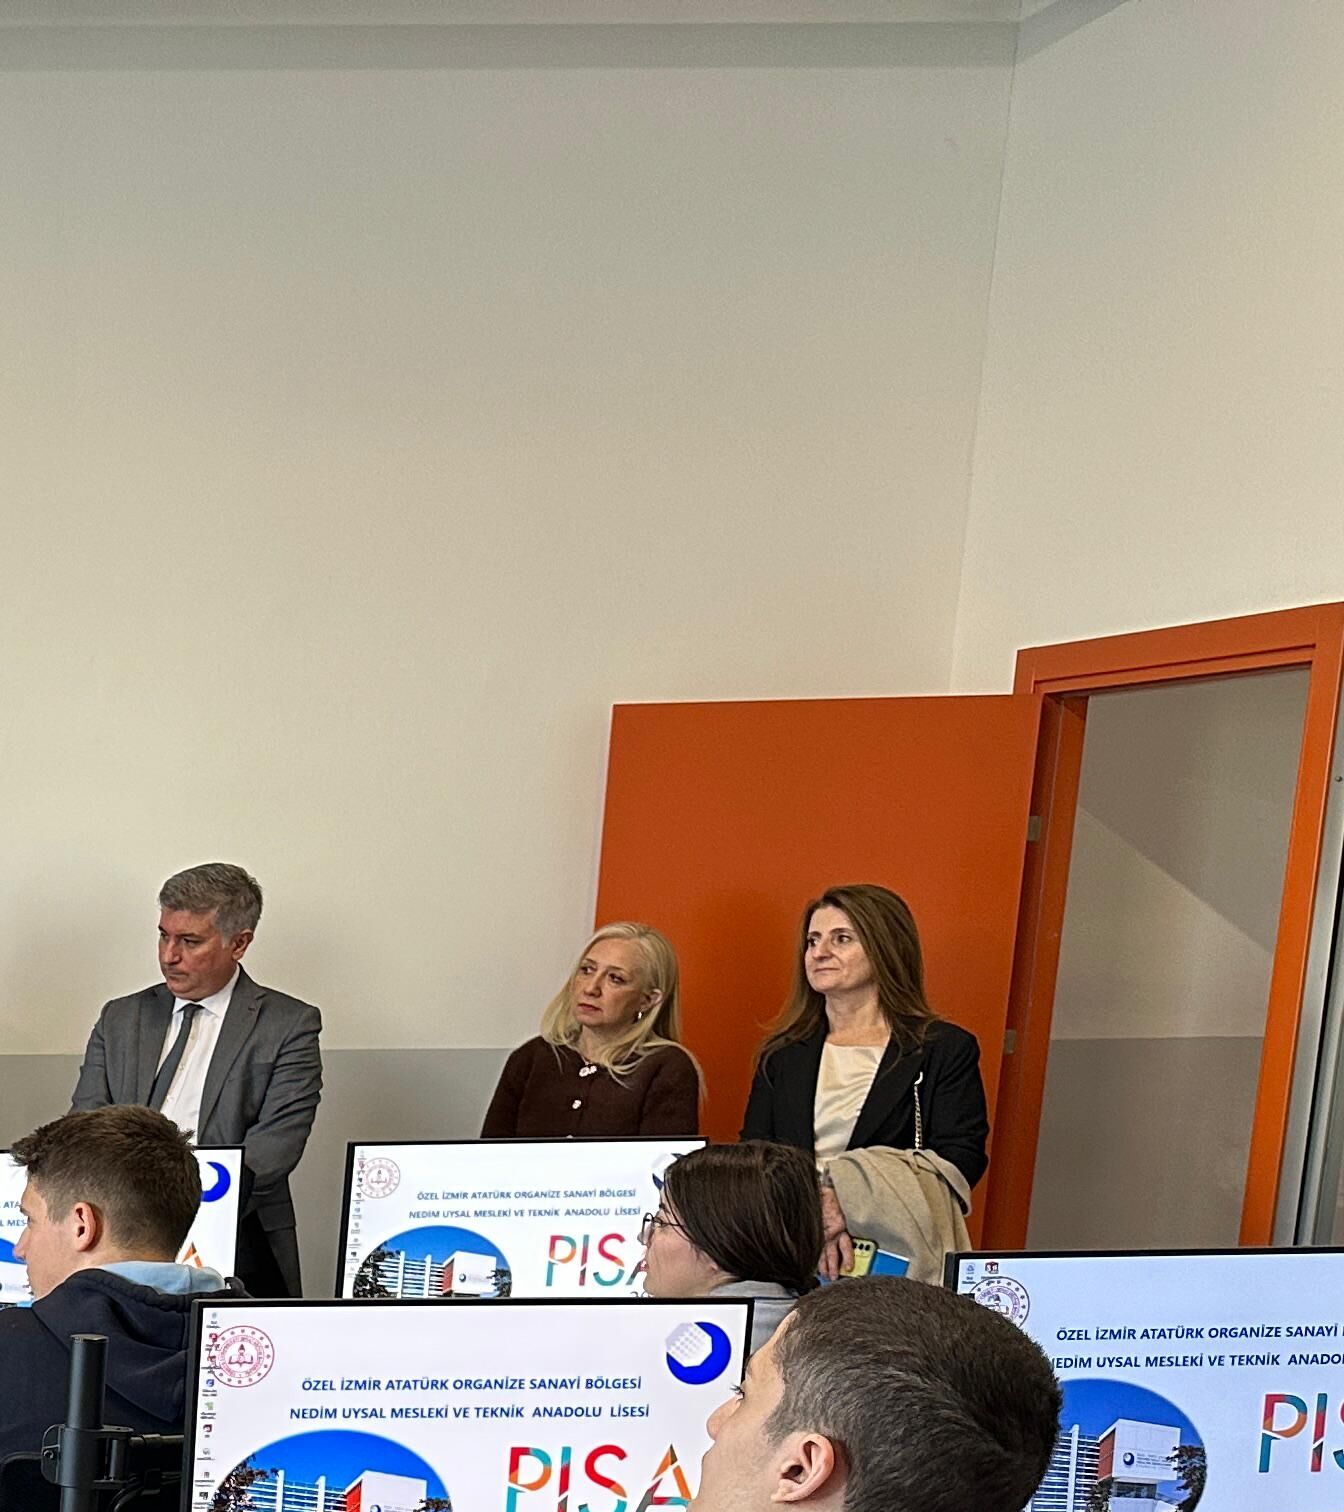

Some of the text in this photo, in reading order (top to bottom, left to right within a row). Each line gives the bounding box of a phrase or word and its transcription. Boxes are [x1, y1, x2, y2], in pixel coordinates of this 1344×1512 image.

[417, 1189, 636, 1200] ÖZEL İZMİR ATATÜRK ORGANİZE SANAYİ BÖLGESİ
[409, 1207, 641, 1219] NEDİM UYSAL MESLEKİ VE TEKNİK ANADOLU LİSESİ
[1056, 1323, 1338, 1340] ÖZEL İZMİR ATATÜRK ORGANİZE SANAYİ
[1096, 1356, 1141, 1368] UYSAL
[1145, 1353, 1203, 1367] MESLEKİ
[1208, 1355, 1225, 1366] VE
[1229, 1352, 1280, 1366] TEKNİK
[1287, 1353, 1344, 1365] ANADO
[302, 1376, 642, 1391] ÖZEL İZMİR ATATÜRK ORGANİZE SANAYİ BÖLGESİ
[289, 1404, 649, 1419] NEDİM UYSAL MESLEKİ VE TEKNİK ANADOLU LİSESİ
[1259, 1393, 1344, 1473] PI
